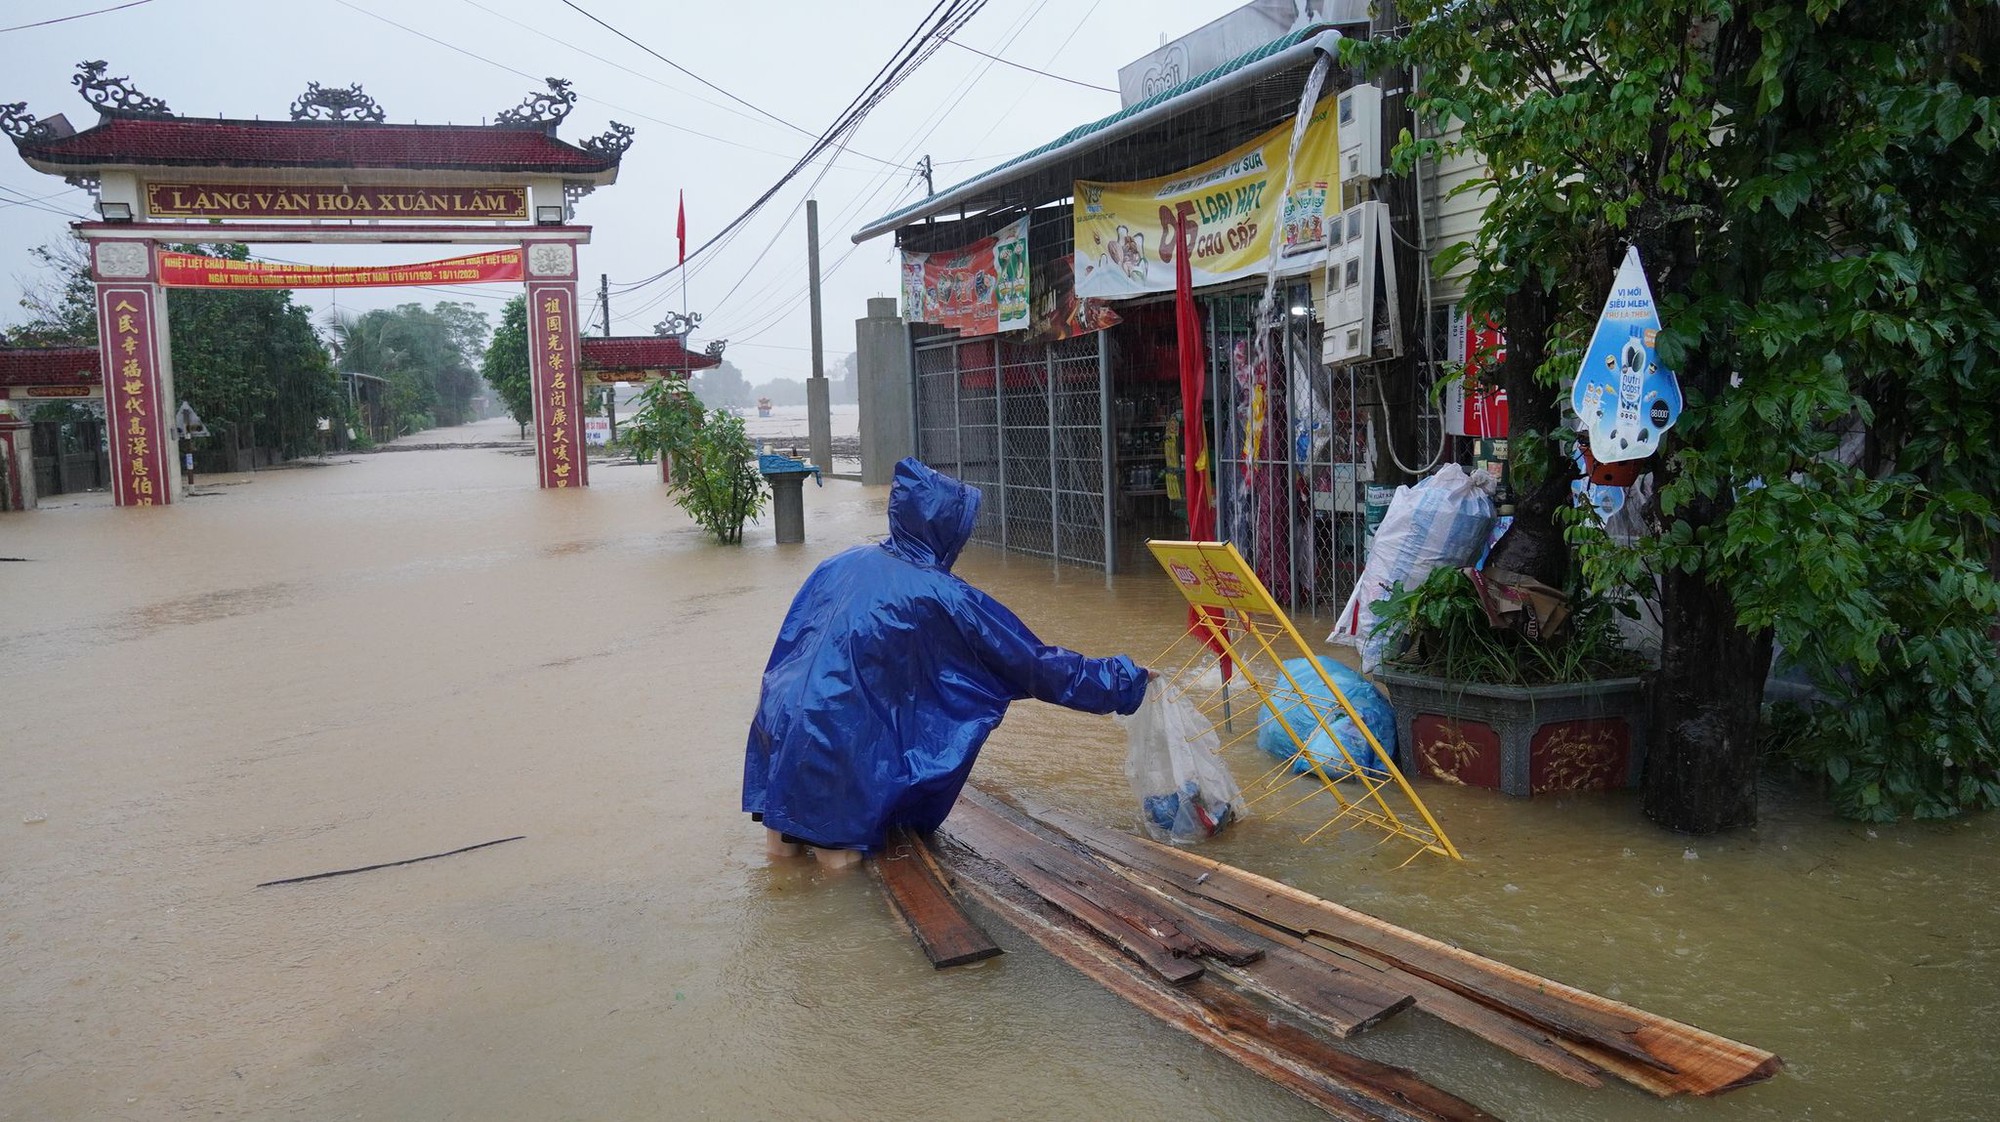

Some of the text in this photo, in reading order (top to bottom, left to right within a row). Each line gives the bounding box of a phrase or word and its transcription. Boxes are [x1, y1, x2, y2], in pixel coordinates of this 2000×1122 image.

[172, 187, 252, 210] LÀNG
[254, 188, 311, 211] VĂN
[377, 190, 448, 211] XUÂN
[453, 190, 507, 211] LÂM
[1195, 180, 1266, 224] LOẠI HẠT
[1197, 217, 1257, 258] CAO CẤP
[164, 257, 186, 270] NHIỆT
[188, 259, 203, 271] LIỆT
[485, 254, 500, 266] VIỆT
[501, 254, 518, 264] NAM
[209, 272, 228, 283] NGÀY
[336, 273, 354, 284] QUỐC
[356, 272, 370, 284] VIỆT
[372, 272, 389, 282] NAM
[1623, 375, 1640, 384] nutri
[1622, 383, 1640, 394] boost
